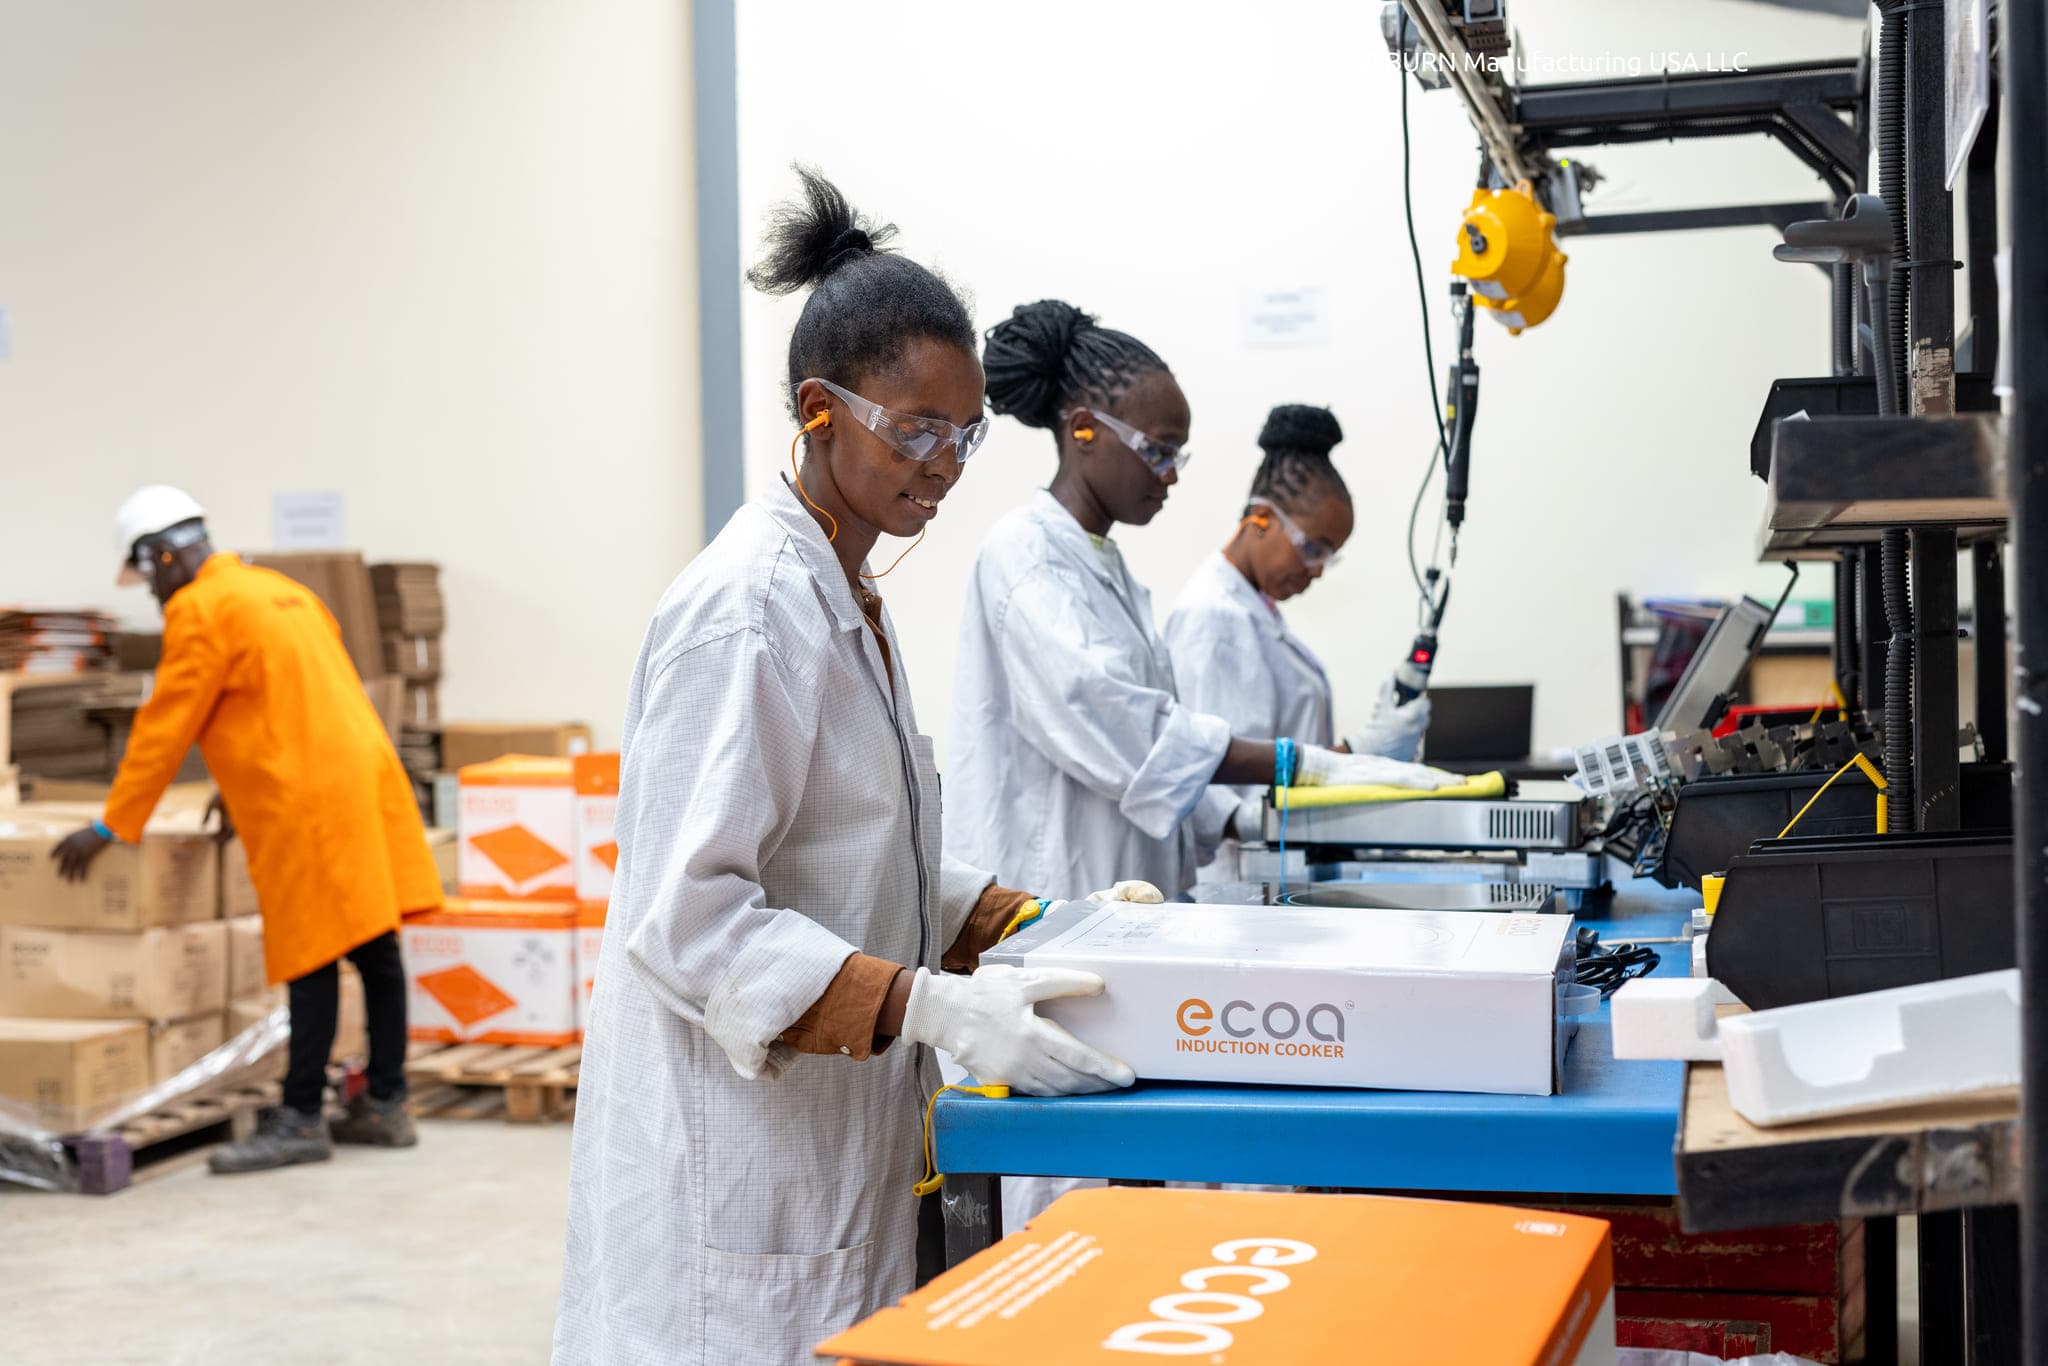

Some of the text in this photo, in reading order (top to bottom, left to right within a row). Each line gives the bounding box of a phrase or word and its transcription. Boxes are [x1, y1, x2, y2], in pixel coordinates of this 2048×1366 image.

[1176, 998, 1345, 1043] ecoa
[1176, 1039, 1345, 1058] INDUCTION COOKER
[1101, 1237, 1318, 1355] ecoa
